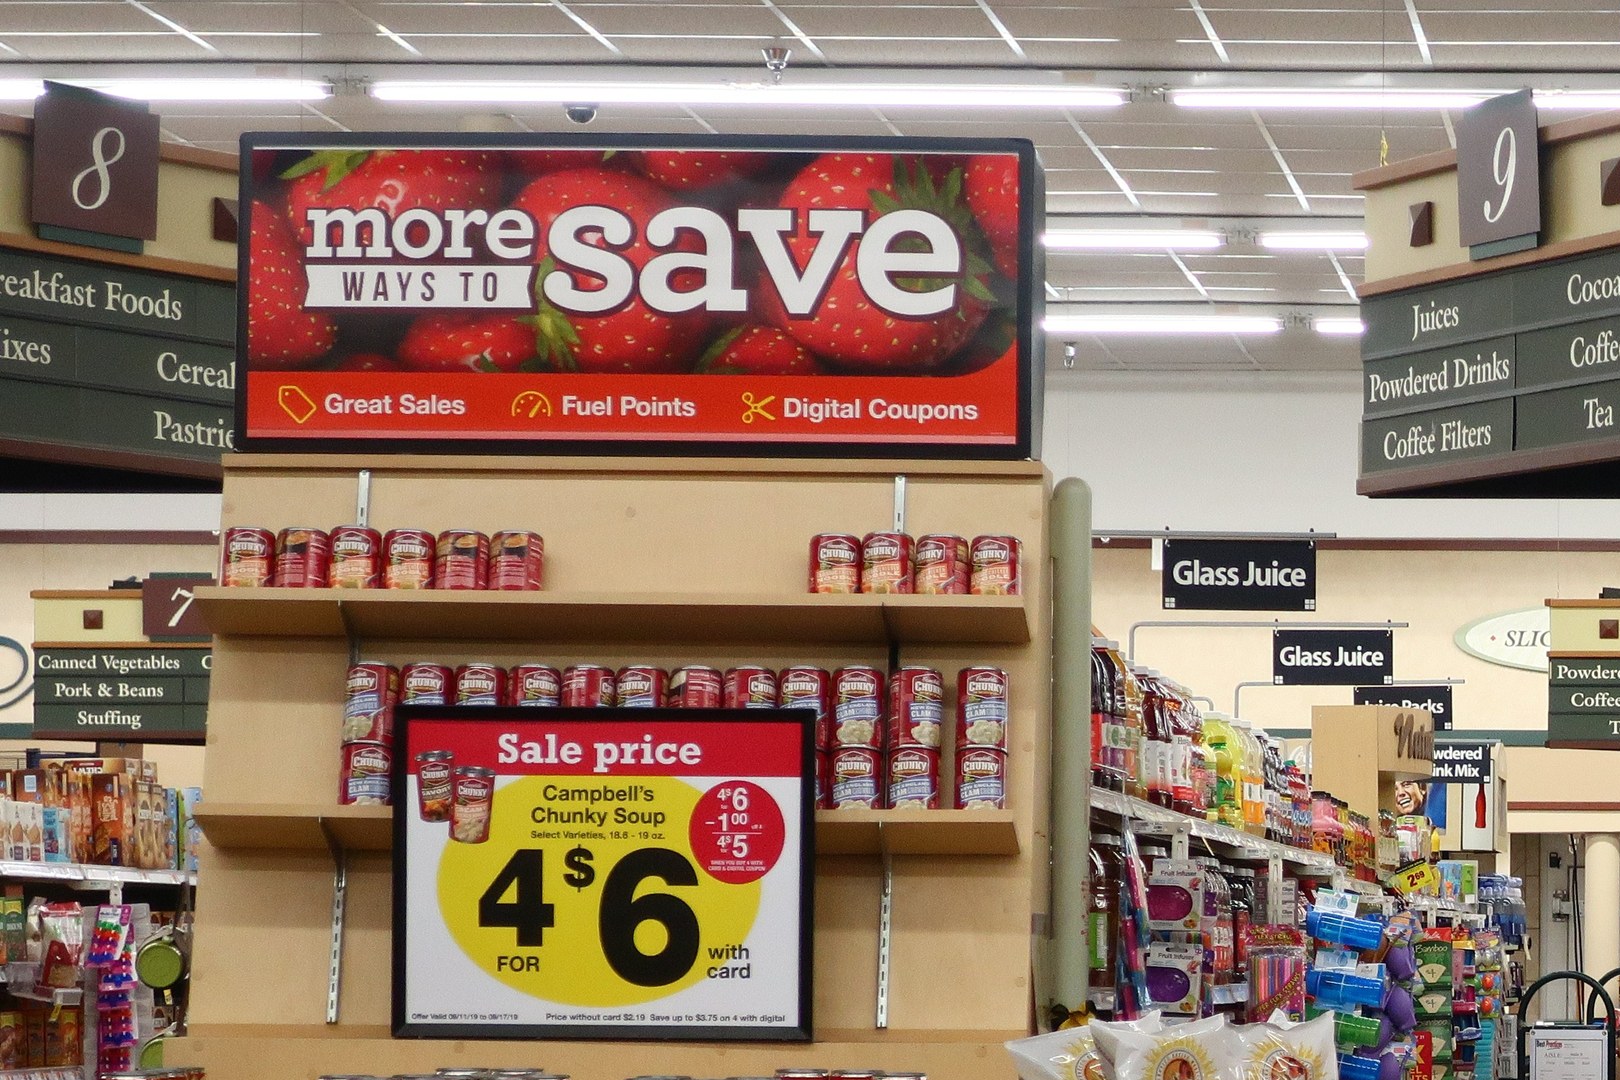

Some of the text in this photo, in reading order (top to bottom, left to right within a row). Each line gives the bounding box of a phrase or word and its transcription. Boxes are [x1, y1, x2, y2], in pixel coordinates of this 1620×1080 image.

[72, 127, 126, 210] 8
[1483, 128, 1516, 223] 9
[306, 208, 538, 259] more
[544, 204, 962, 315] save
[0, 270, 182, 320] eakfast Foods
[342, 271, 499, 301] WAYS TO
[1412, 301, 1459, 340] Juices
[0, 329, 51, 364] ixes
[1368, 355, 1509, 403] Powdered Drinks
[324, 393, 465, 416] Great Sales
[562, 395, 695, 418] Fuel Points
[784, 398, 978, 424] Digital Coupons
[1584, 398, 1613, 429] Tea
[154, 410, 235, 449] Pastrie
[1383, 423, 1491, 461] Coffee Filters
[1172, 560, 1307, 588] Glass Juice
[168, 587, 194, 627] 7
[38, 655, 180, 674] Canned Vegetables
[1279, 646, 1384, 667] Glass Juice
[54, 683, 164, 697] Pork & Beans
[783, 682, 817, 693] CHUNKY
[77, 711, 141, 729] Stuffing
[498, 733, 701, 773] Sale price
[1434, 747, 1482, 760] wdered
[1455, 764, 1479, 777] Mix
[530, 807, 666, 827] Chunky Soup
[530, 831, 560, 839] Select
[563, 831, 606, 840] Varieties,
[639, 831, 647, 839] 19
[478, 848, 554, 947] 4
[708, 946, 750, 960] with
[1415, 944, 1447, 953] Bamboo
[497, 956, 540, 972] FOR
[707, 963, 751, 979] card
[650, 1014, 670, 1022] Save
[759, 1015, 785, 1024] digital
